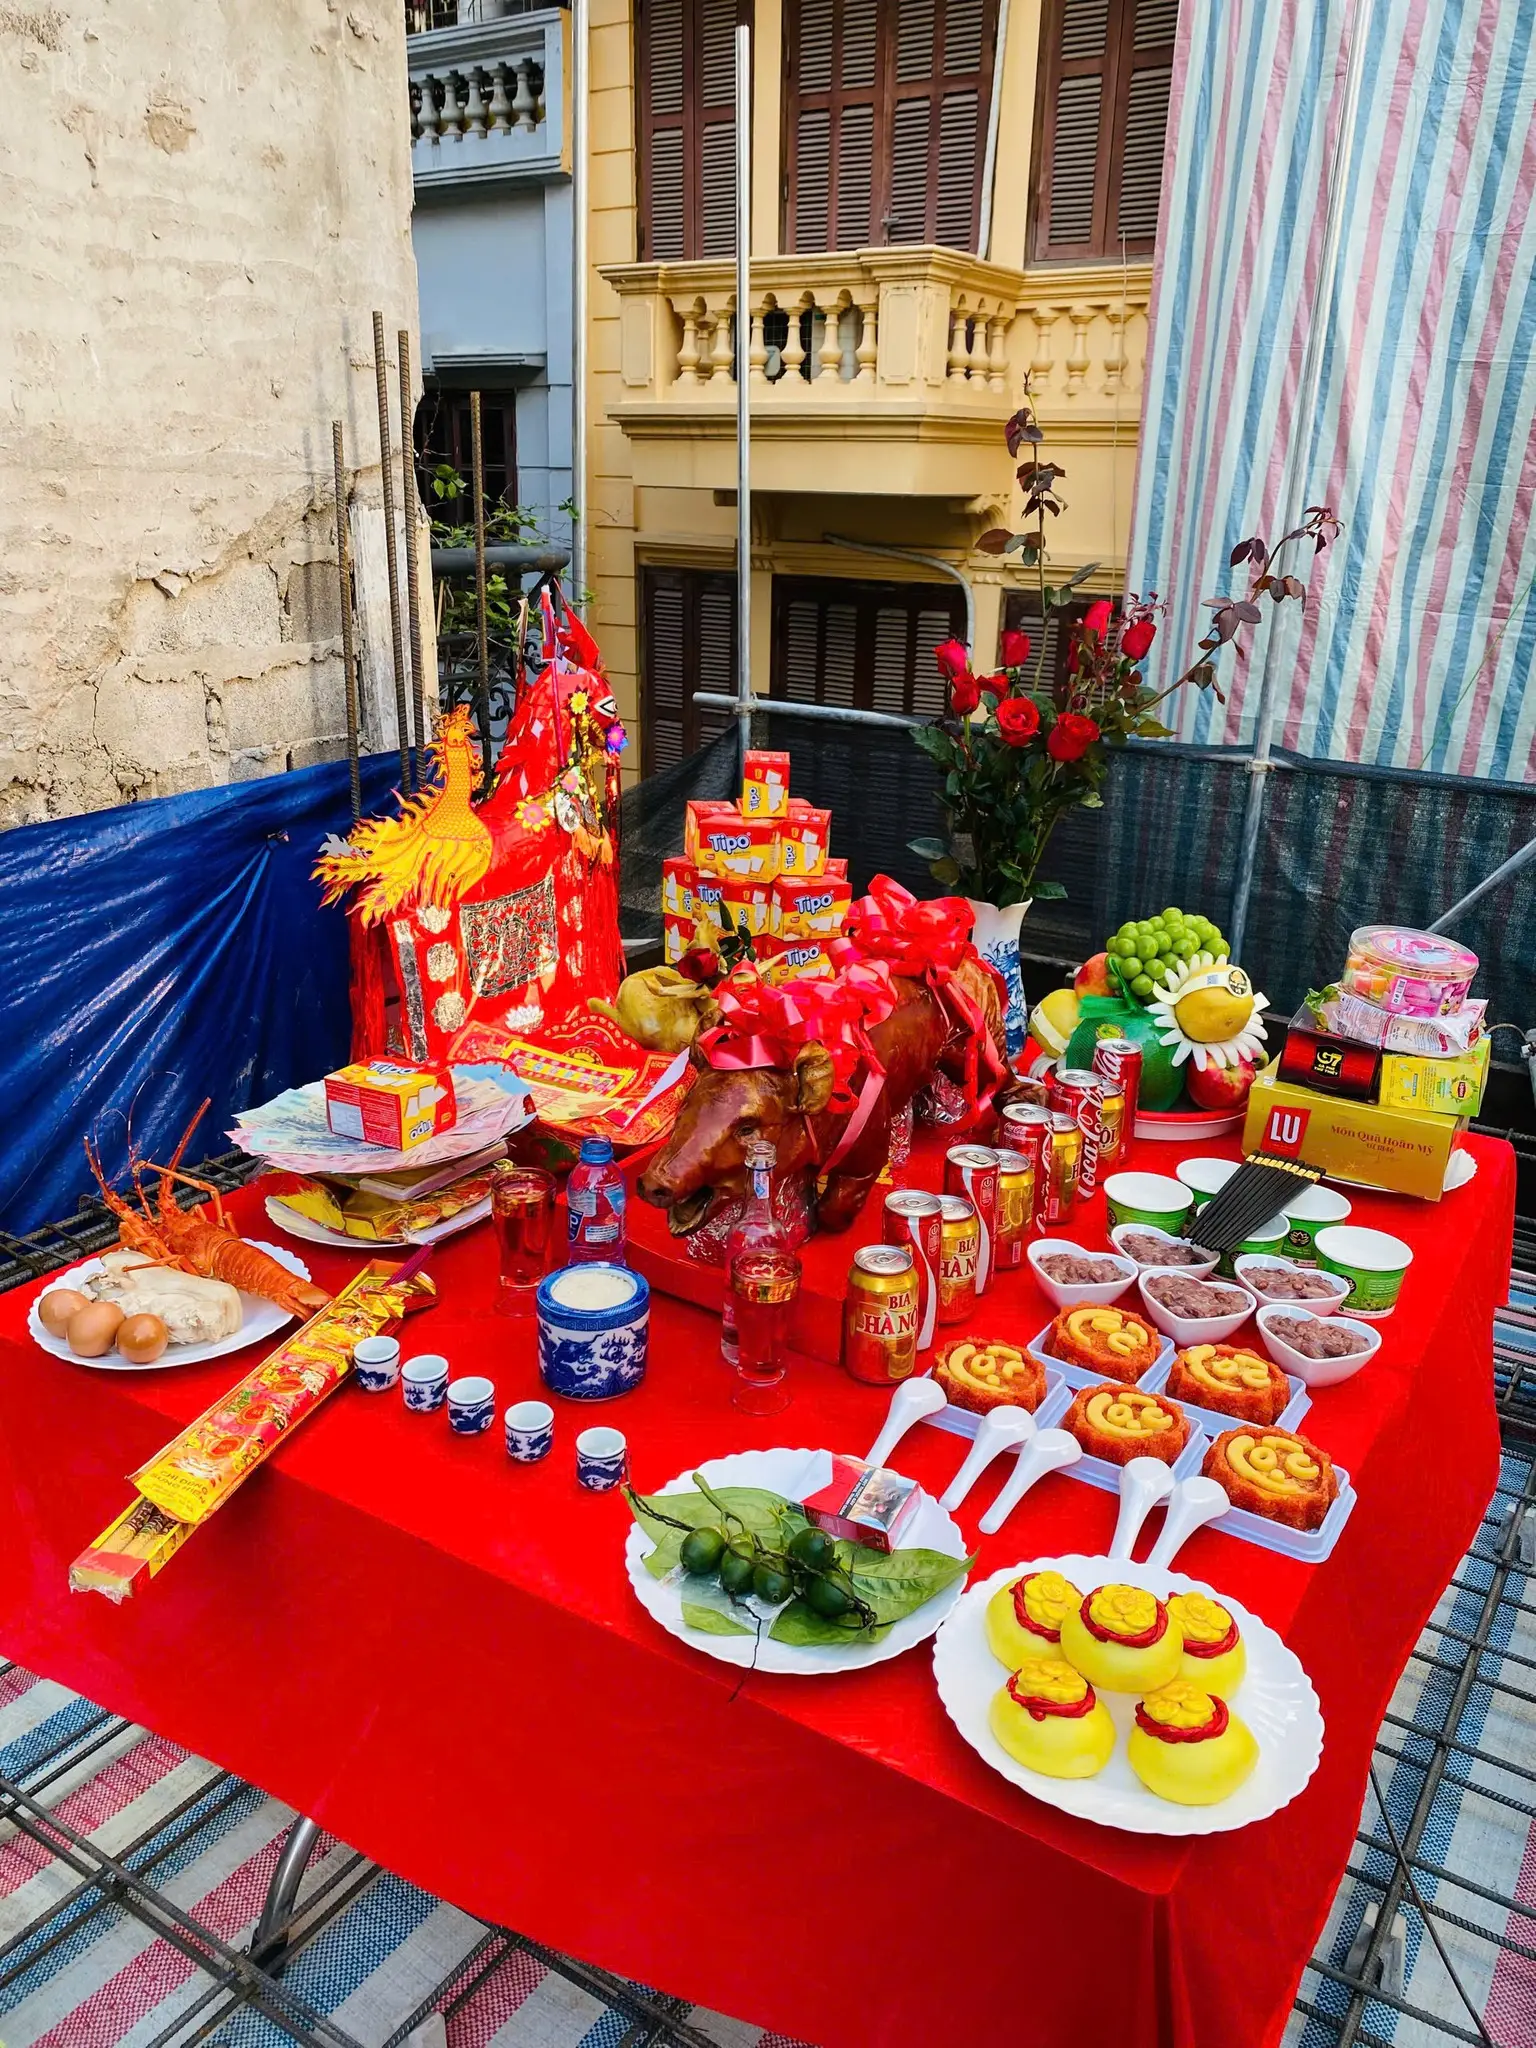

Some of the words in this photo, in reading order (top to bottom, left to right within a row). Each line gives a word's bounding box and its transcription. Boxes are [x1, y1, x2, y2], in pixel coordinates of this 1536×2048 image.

[749, 787, 760, 812] Tipo
[708, 833, 751, 855] Tipo
[785, 845, 796, 869] Tipo
[697, 884, 722, 906] Tipo
[794, 893, 834, 916] Tipo
[785, 945, 820, 967] Tipo
[368, 1061, 418, 1075] Tipo
[1270, 1111, 1301, 1144] LU
[958, 1237, 976, 1254] BIA
[889, 1293, 911, 1309] BIA
[863, 1311, 895, 1335] HÀ
